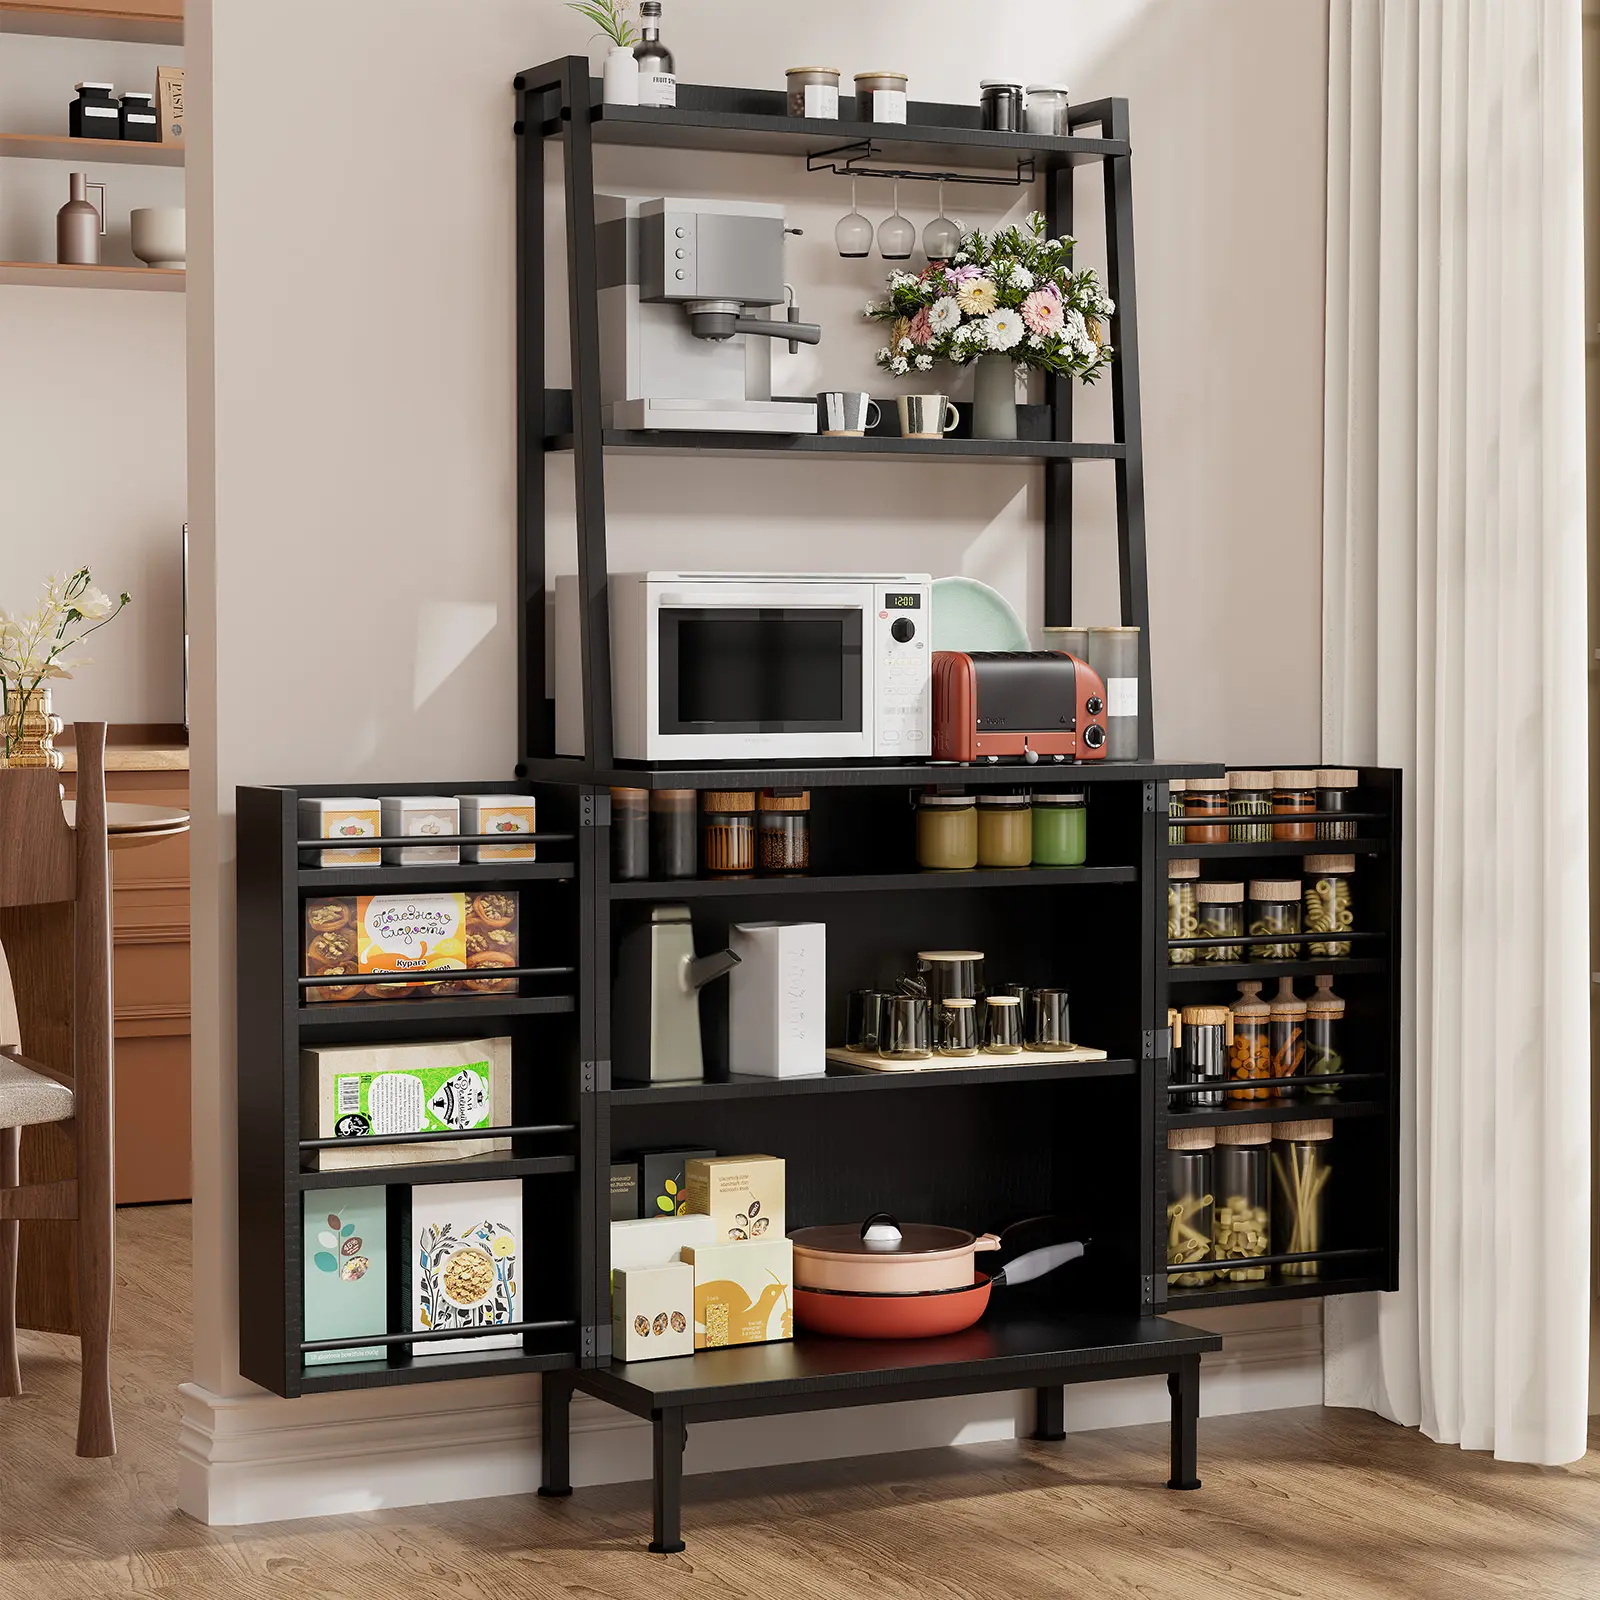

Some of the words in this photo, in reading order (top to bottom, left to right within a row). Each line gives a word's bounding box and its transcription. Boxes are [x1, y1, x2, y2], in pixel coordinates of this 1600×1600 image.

[172, 83, 184, 119] PASTA
[894, 596, 914, 606] 12:00
[373, 905, 452, 928] Полезная
[379, 922, 445, 945] Сладость
[397, 959, 427, 968] Курага
